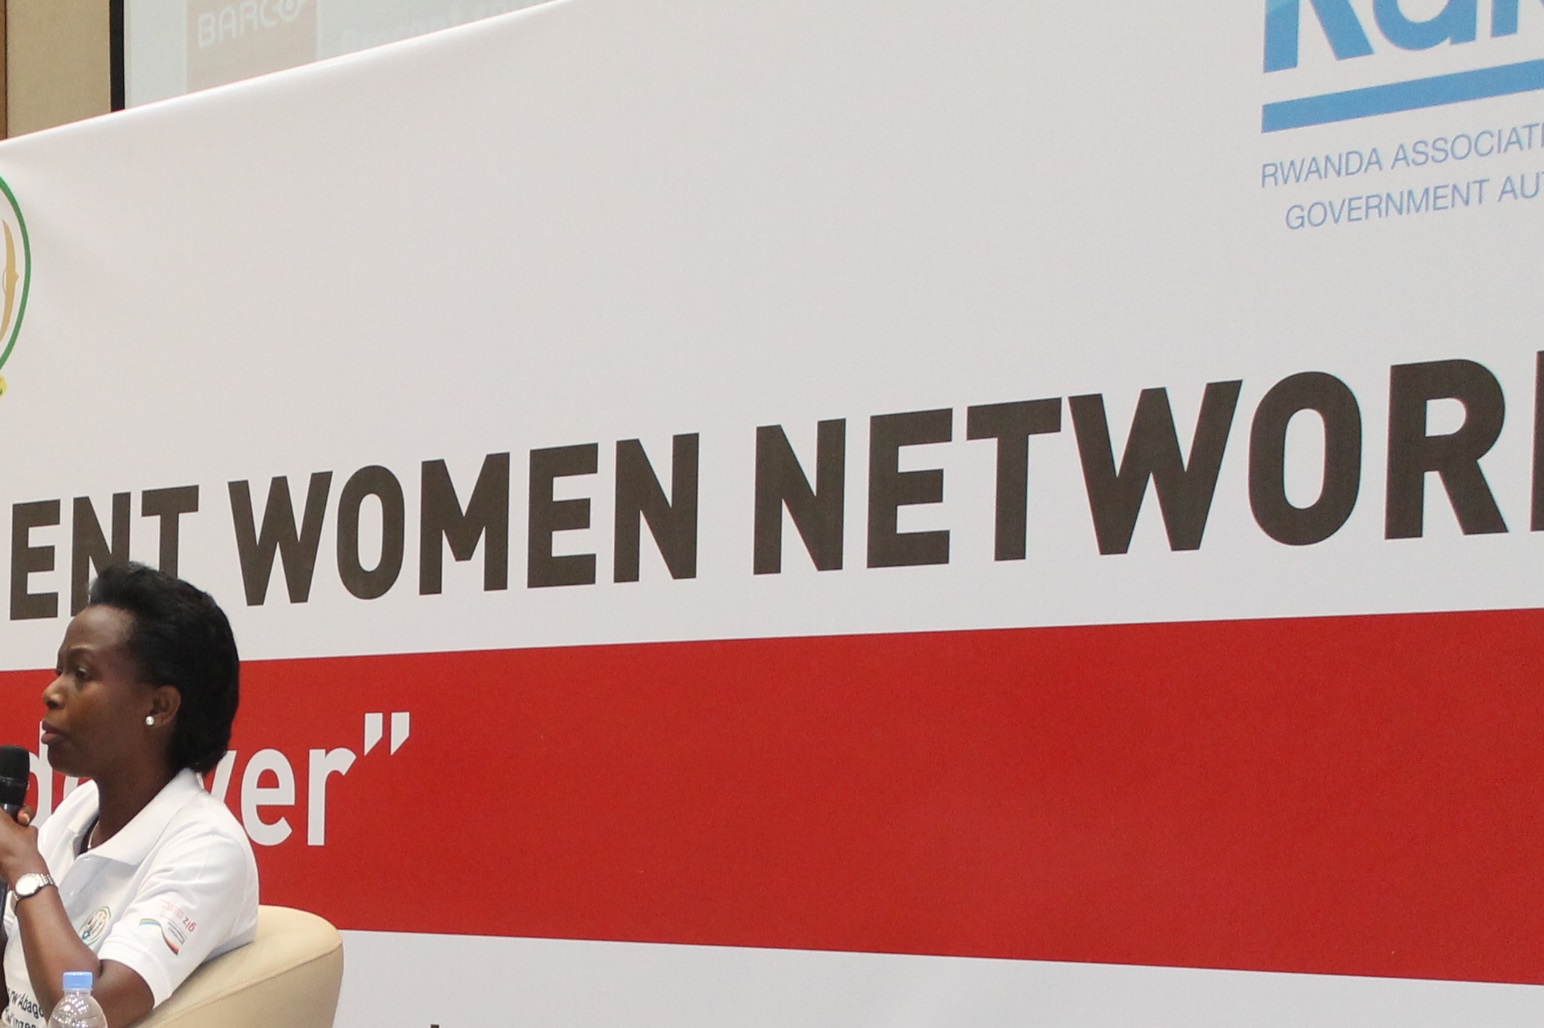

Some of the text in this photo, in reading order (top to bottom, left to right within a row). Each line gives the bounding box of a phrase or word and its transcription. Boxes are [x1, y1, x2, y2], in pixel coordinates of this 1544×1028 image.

[1261, 148, 1383, 188] RWANDA
[1285, 179, 1490, 230] GOVERNMENT
[228, 433, 700, 607] WOMEN
[754, 352, 1544, 577] NETWOR
